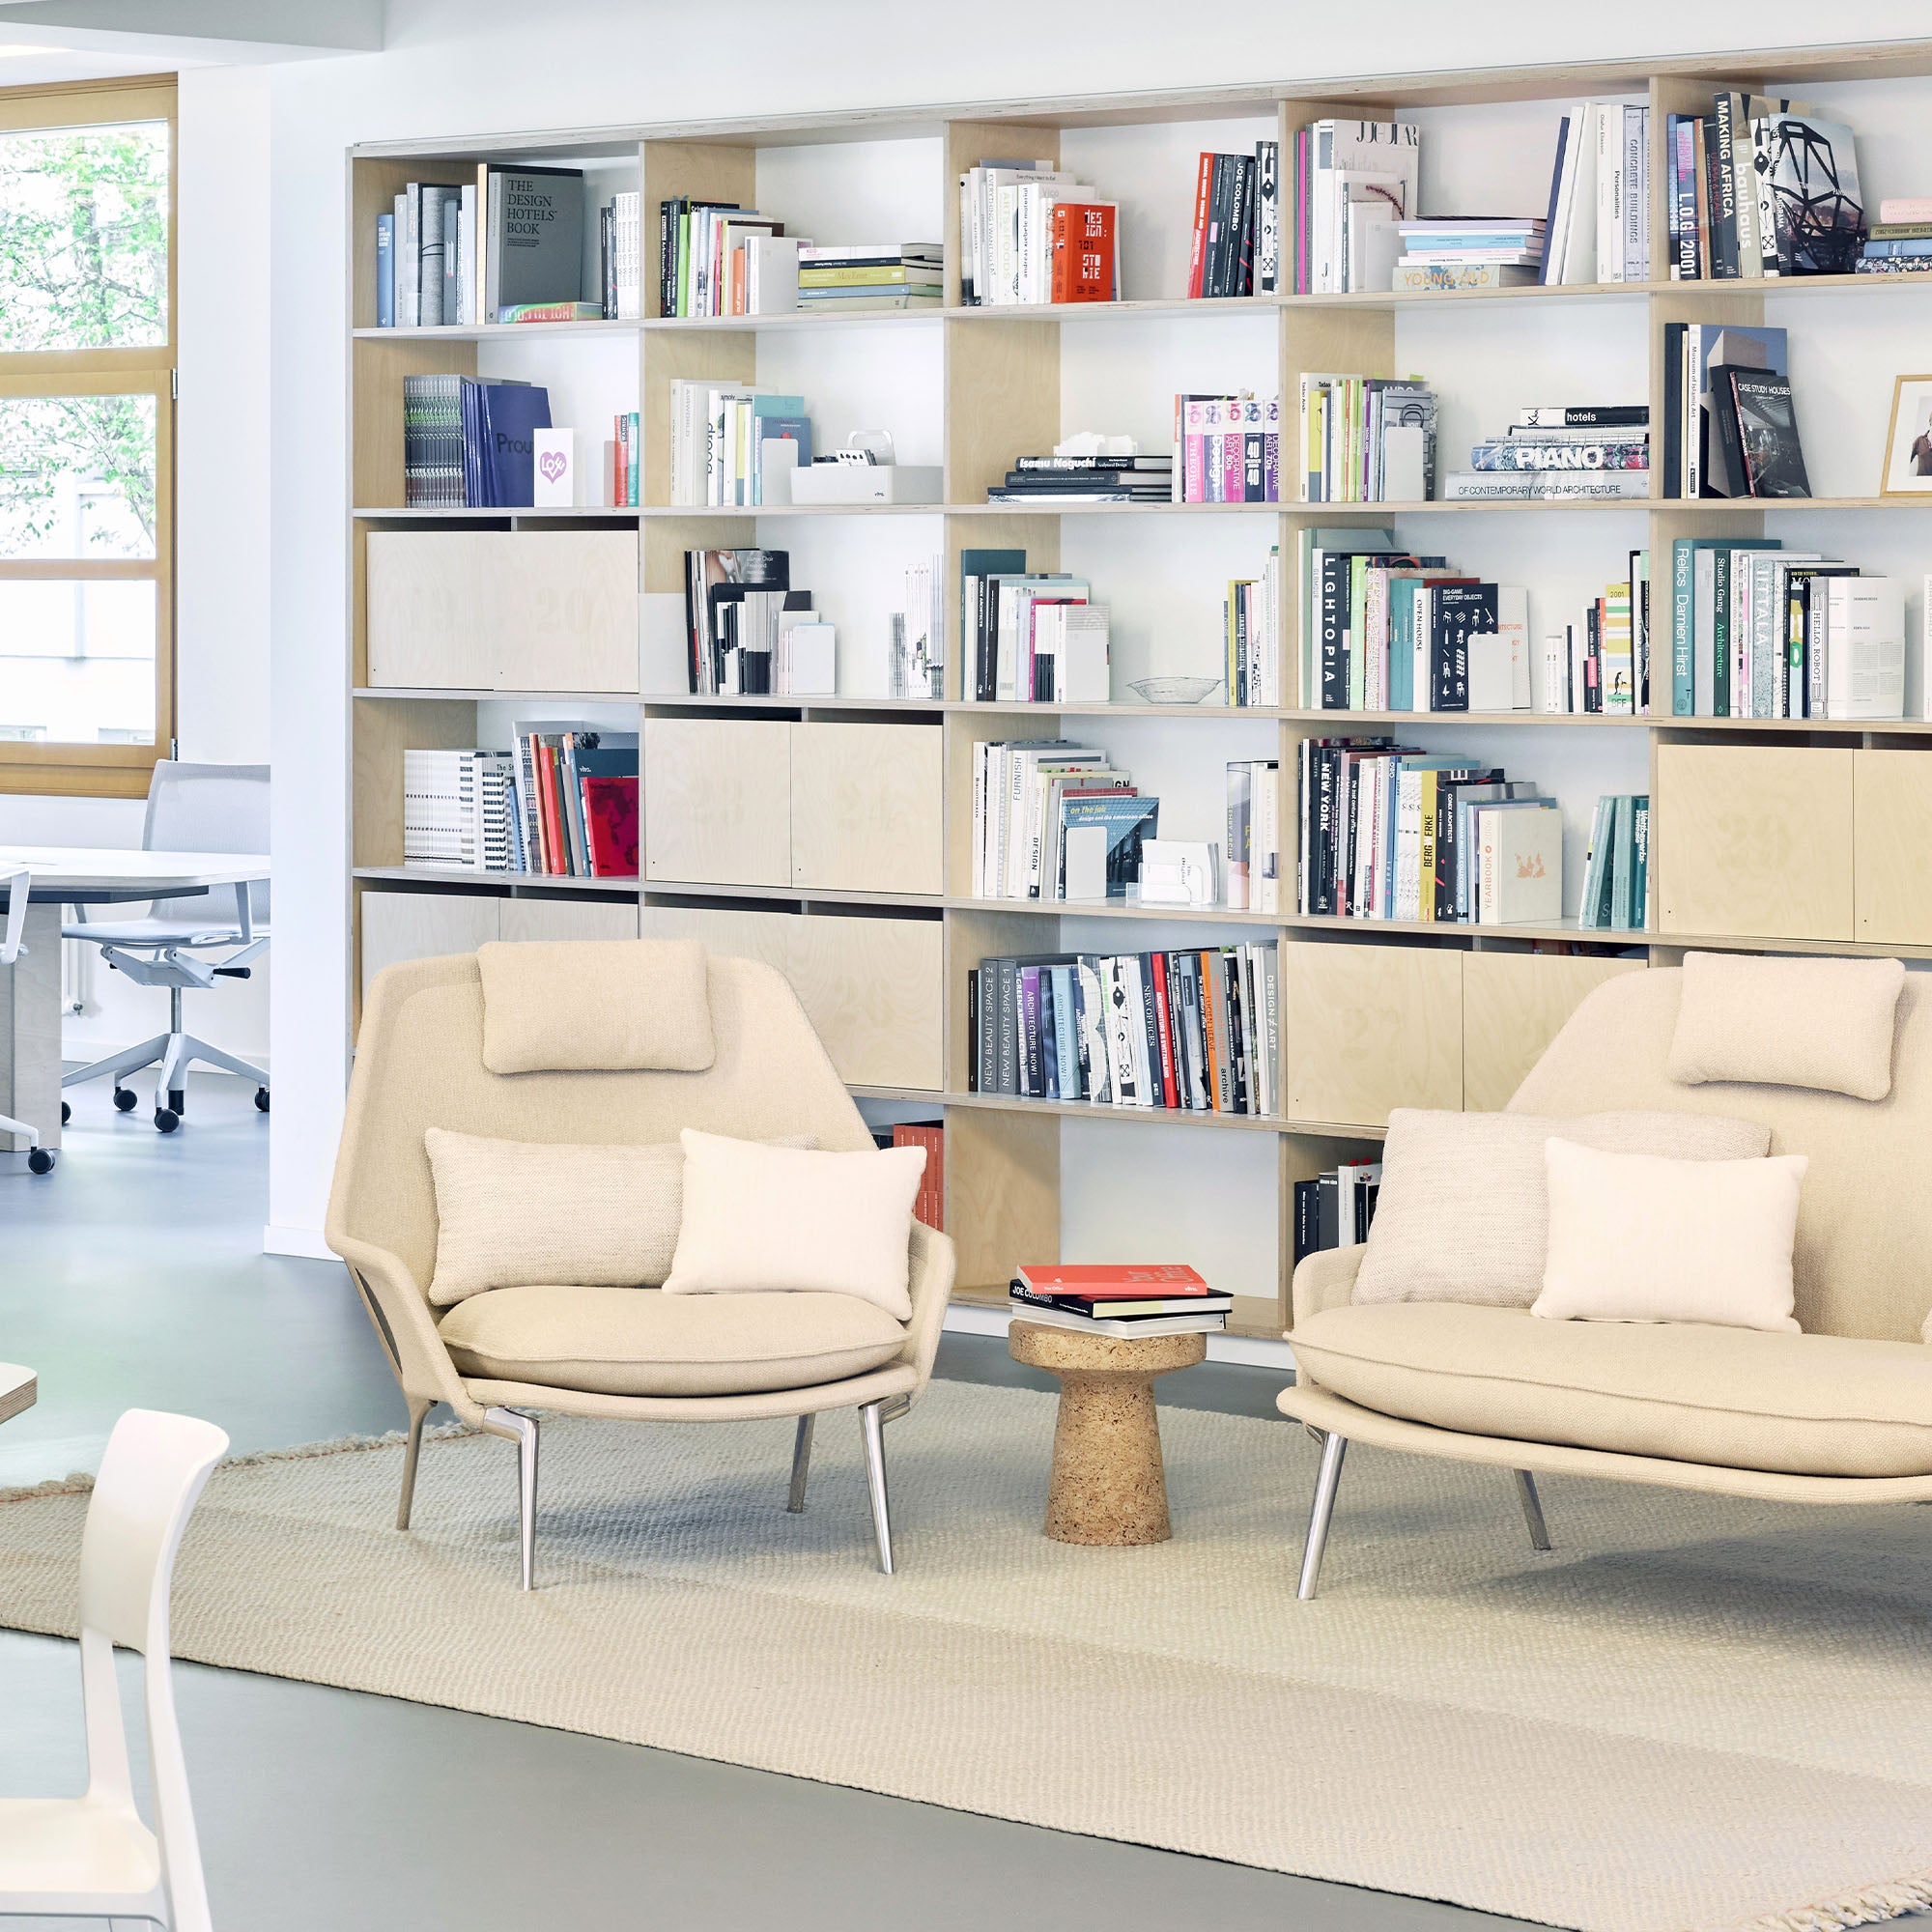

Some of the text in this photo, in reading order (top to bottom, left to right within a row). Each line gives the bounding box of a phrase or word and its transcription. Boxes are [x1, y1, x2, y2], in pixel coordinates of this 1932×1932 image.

[1718, 100, 1734, 218] MAKING AFRICA
[508, 180, 533, 191] THE
[508, 194, 553, 207] DESIGN
[1232, 184, 1242, 231] COLOMBO
[1630, 140, 1638, 244] CONCRETE BUILDINGS
[1736, 162, 1754, 249] bauhaus
[507, 222, 540, 235] BOOK
[1678, 194, 1695, 275] L.O.G. 2001
[1737, 383, 1790, 396] CASE STUDY HOUSES
[1566, 412, 1596, 422] hotels
[496, 432, 534, 454] Prou
[1020, 457, 1096, 469] Isamu Noguchi
[1209, 435, 1222, 487] Design
[1516, 448, 1604, 469] PIANO
[1459, 485, 1621, 495] OF CONTEMPORARY WORLD ARCHITECTURE
[1325, 558, 1335, 682] LIGHTOPIA
[1676, 548, 1689, 676] Relics Damien Hirst
[1716, 557, 1726, 677] Studio Gang Architecture
[1756, 570, 1769, 645] IITTALA
[1013, 757, 1022, 801] FURNISH
[1321, 763, 1330, 831] NEW YORK
[1267, 975, 1276, 1016] DESIGN
[1018, 1009, 1026, 1070] ARCHITECTURE
[1027, 991, 1036, 1051] ARCHITECTURE
[1056, 993, 1066, 1052] ARCHITECTURE
[1146, 1008, 1155, 1047] OFFICES
[1156, 992, 1165, 1032] ARCHITECTURE
[1161, 1040, 1169, 1079] SWITZERLAND
[984, 1058, 993, 1085] NEW
[1220, 1068, 1229, 1104] archive
[1012, 1286, 1025, 1297] JOE
